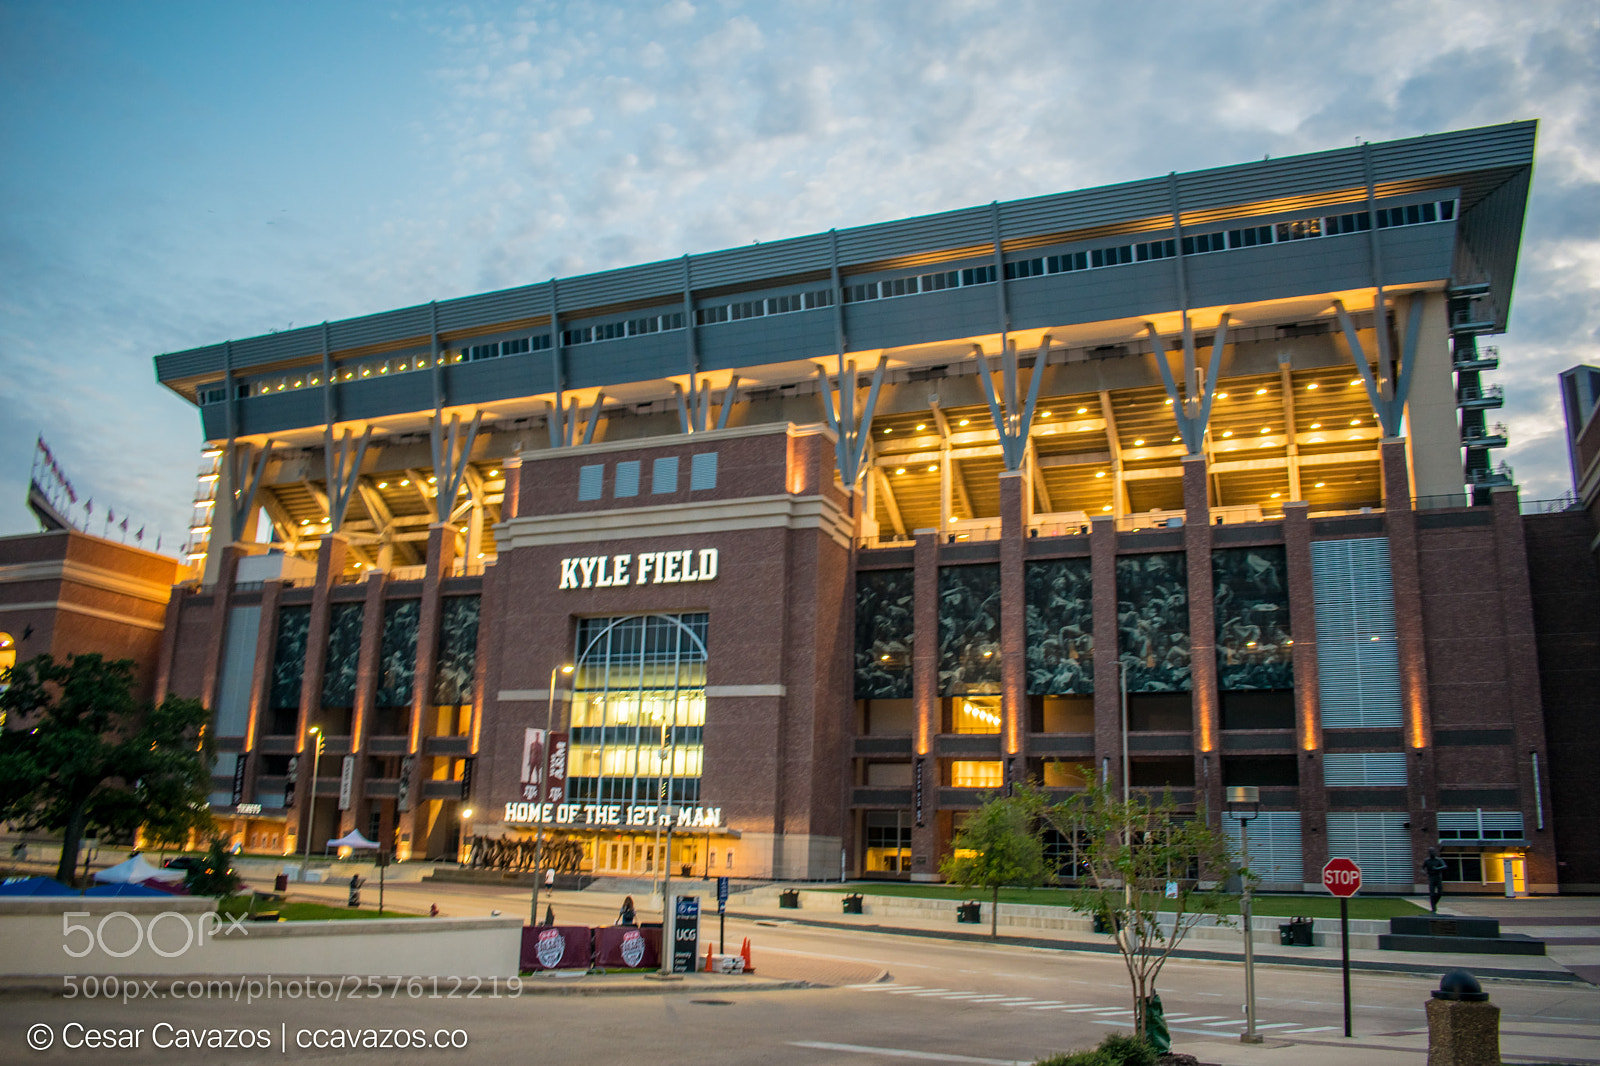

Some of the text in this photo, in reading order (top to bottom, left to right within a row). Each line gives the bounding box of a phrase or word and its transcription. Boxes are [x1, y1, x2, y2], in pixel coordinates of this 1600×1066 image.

[559, 548, 718, 589] KYLE FIELD
[504, 802, 553, 822] HOME
[556, 804, 580, 823] OF
[584, 804, 620, 824] THE
[677, 806, 721, 827] MAN
[1325, 869, 1359, 885] STOP
[676, 928, 696, 941] UCG
